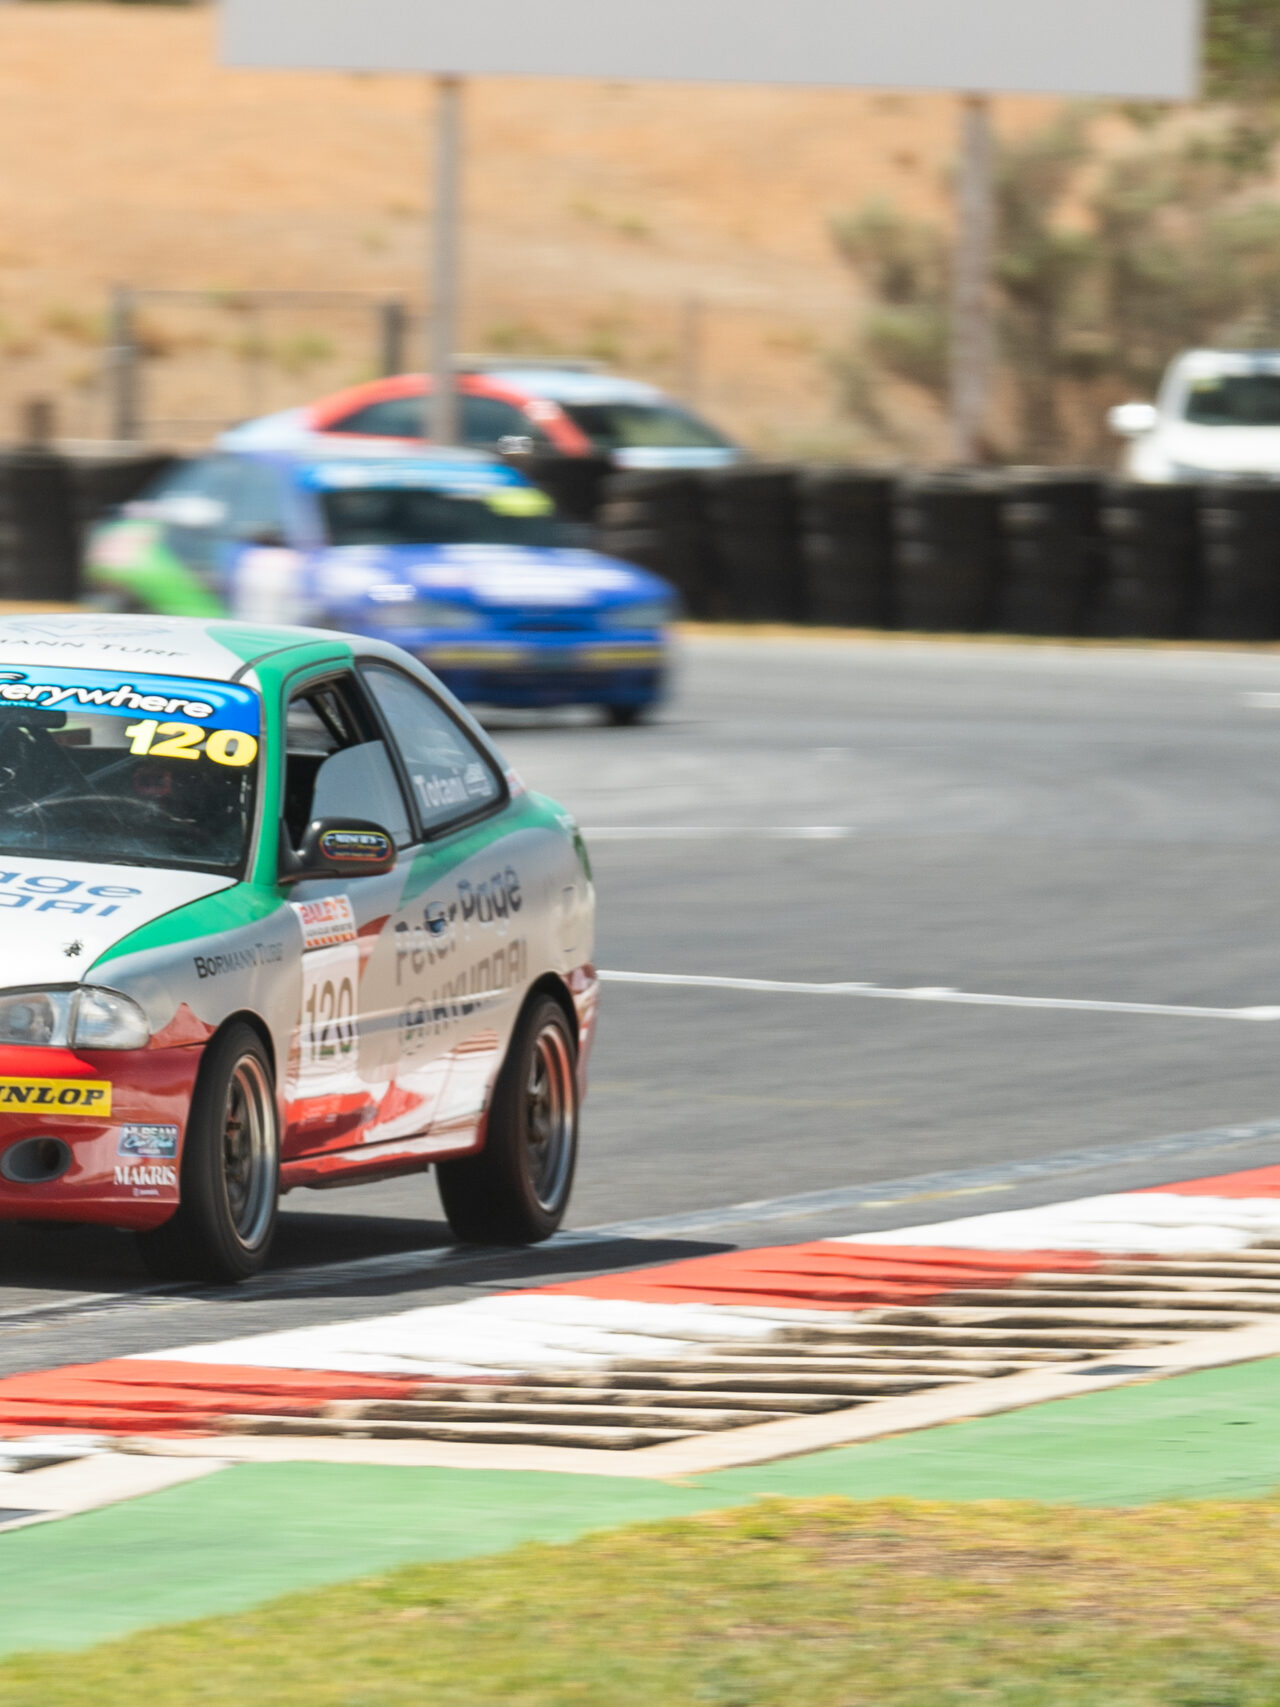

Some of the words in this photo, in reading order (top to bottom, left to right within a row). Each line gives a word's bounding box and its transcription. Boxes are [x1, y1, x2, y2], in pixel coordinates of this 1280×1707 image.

[101, 643, 191, 656] TURF
[125, 719, 258, 767] 120
[306, 976, 354, 1063] 120
[113, 1164, 177, 1186] MAKRIS
